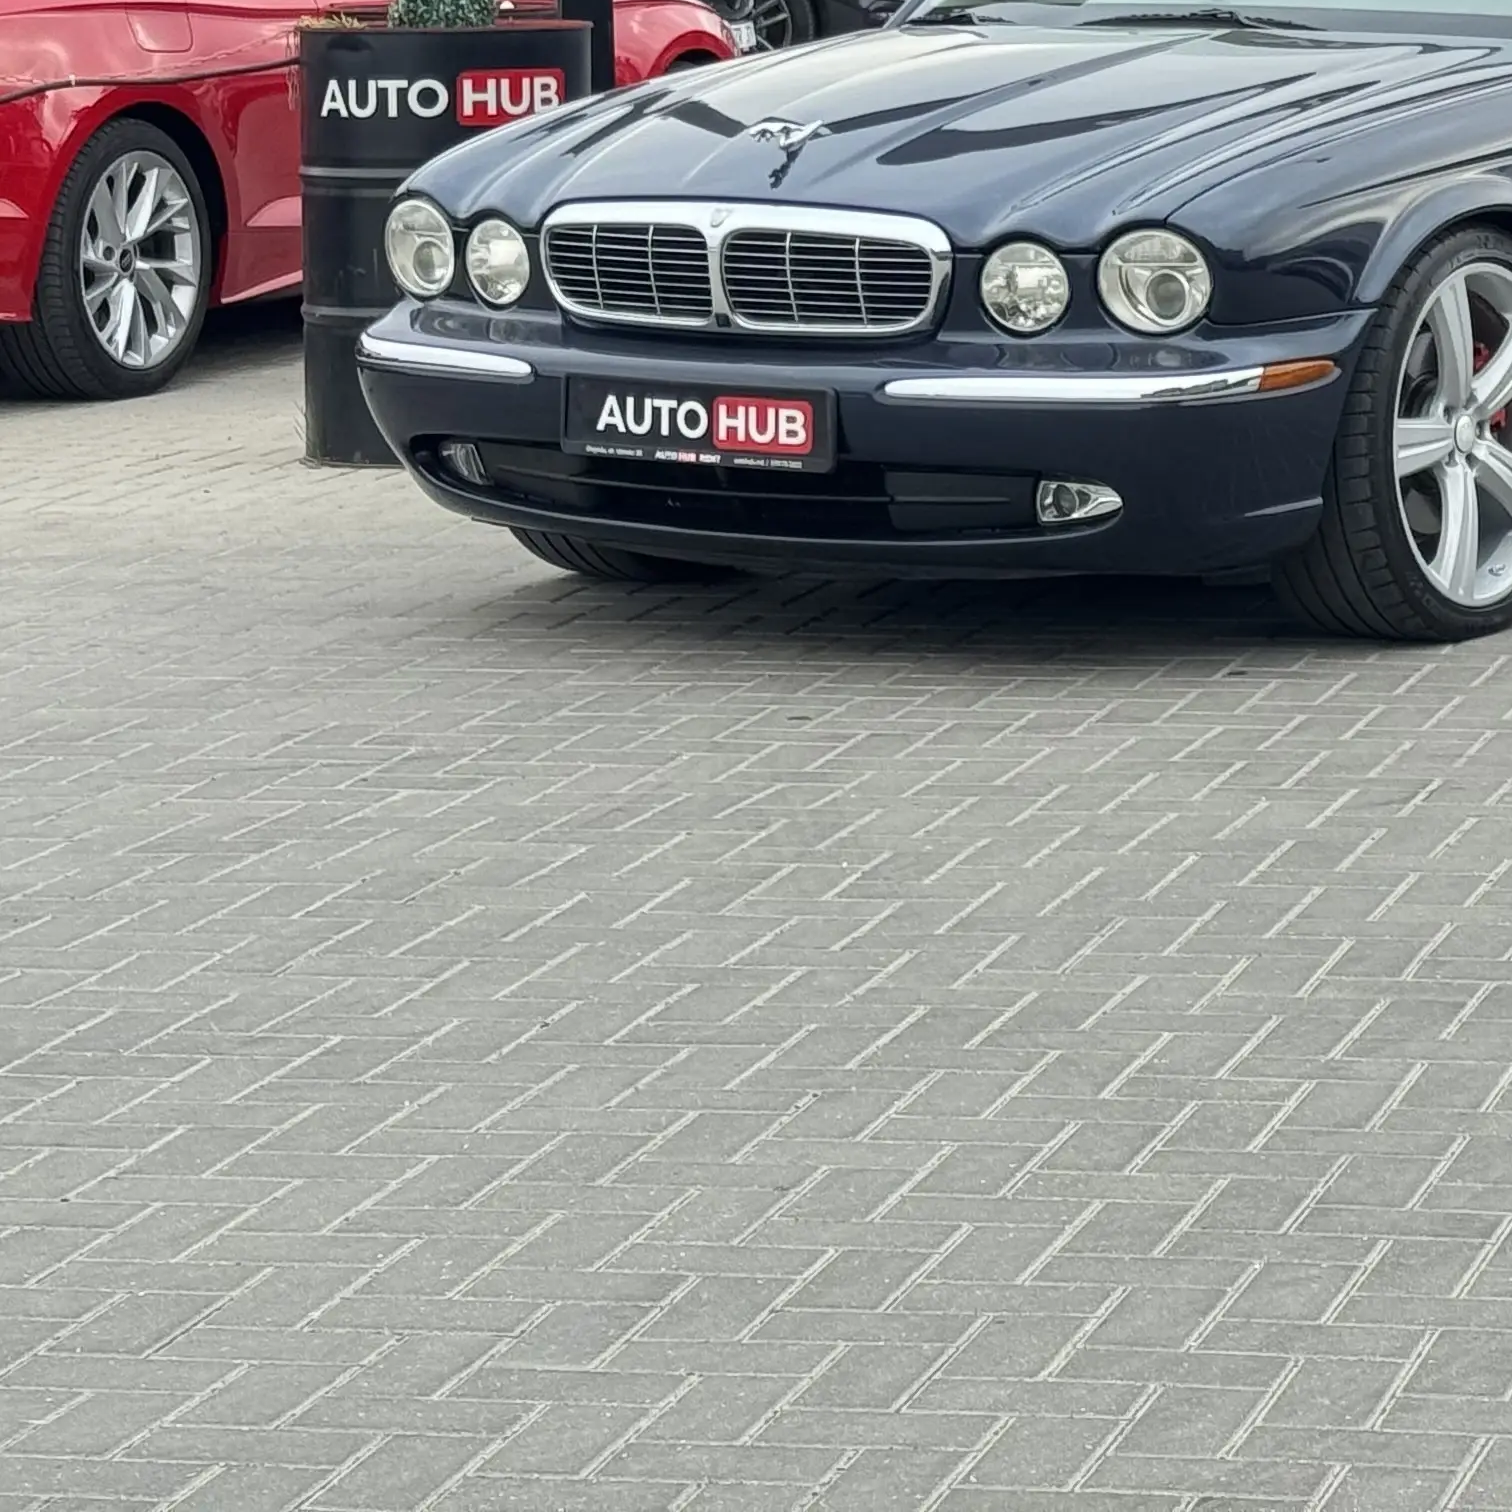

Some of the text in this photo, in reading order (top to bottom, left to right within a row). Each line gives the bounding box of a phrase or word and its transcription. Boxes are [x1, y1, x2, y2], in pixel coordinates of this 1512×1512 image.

[320, 76, 560, 118] AUTO HUB
[596, 394, 807, 445] AUTO HUB
